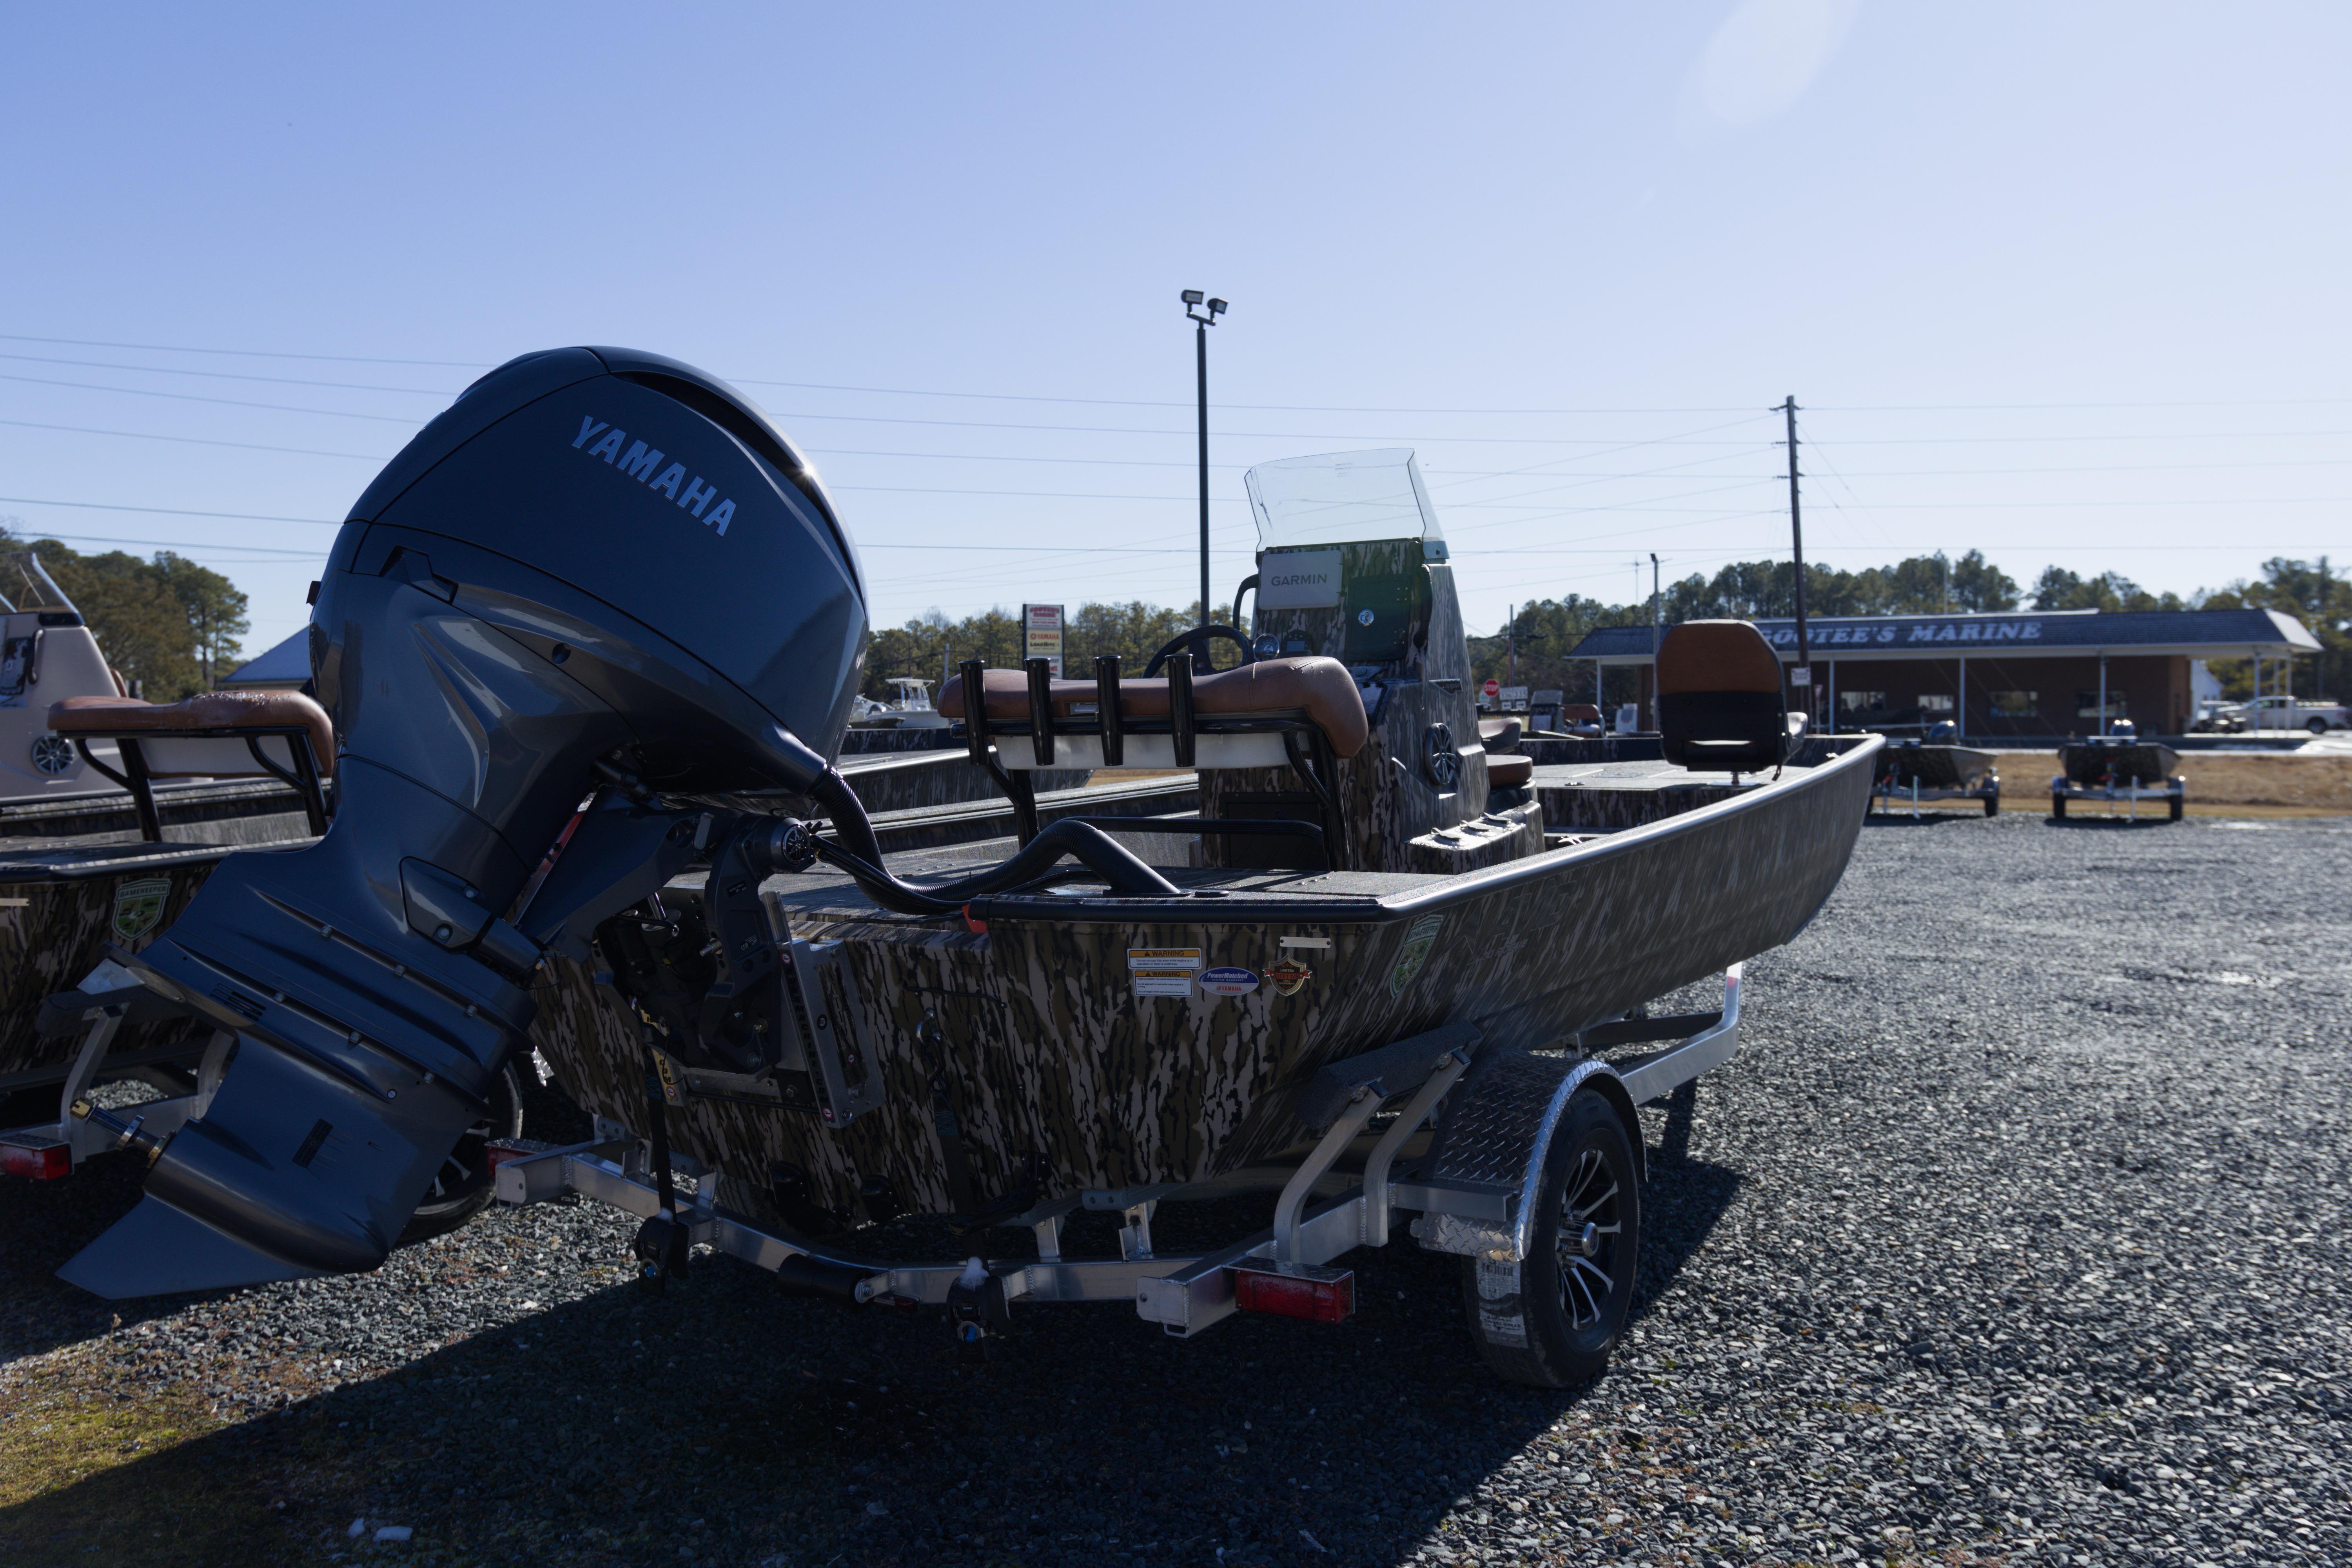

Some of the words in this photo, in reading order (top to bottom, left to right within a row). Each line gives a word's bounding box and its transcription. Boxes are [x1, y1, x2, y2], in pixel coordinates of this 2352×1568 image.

[572, 415, 736, 537] YAMAHA
[1271, 573, 1327, 586] GARMIN
[1908, 622, 2042, 642] MARINE
[120, 886, 166, 897] GAMEKEEPER
